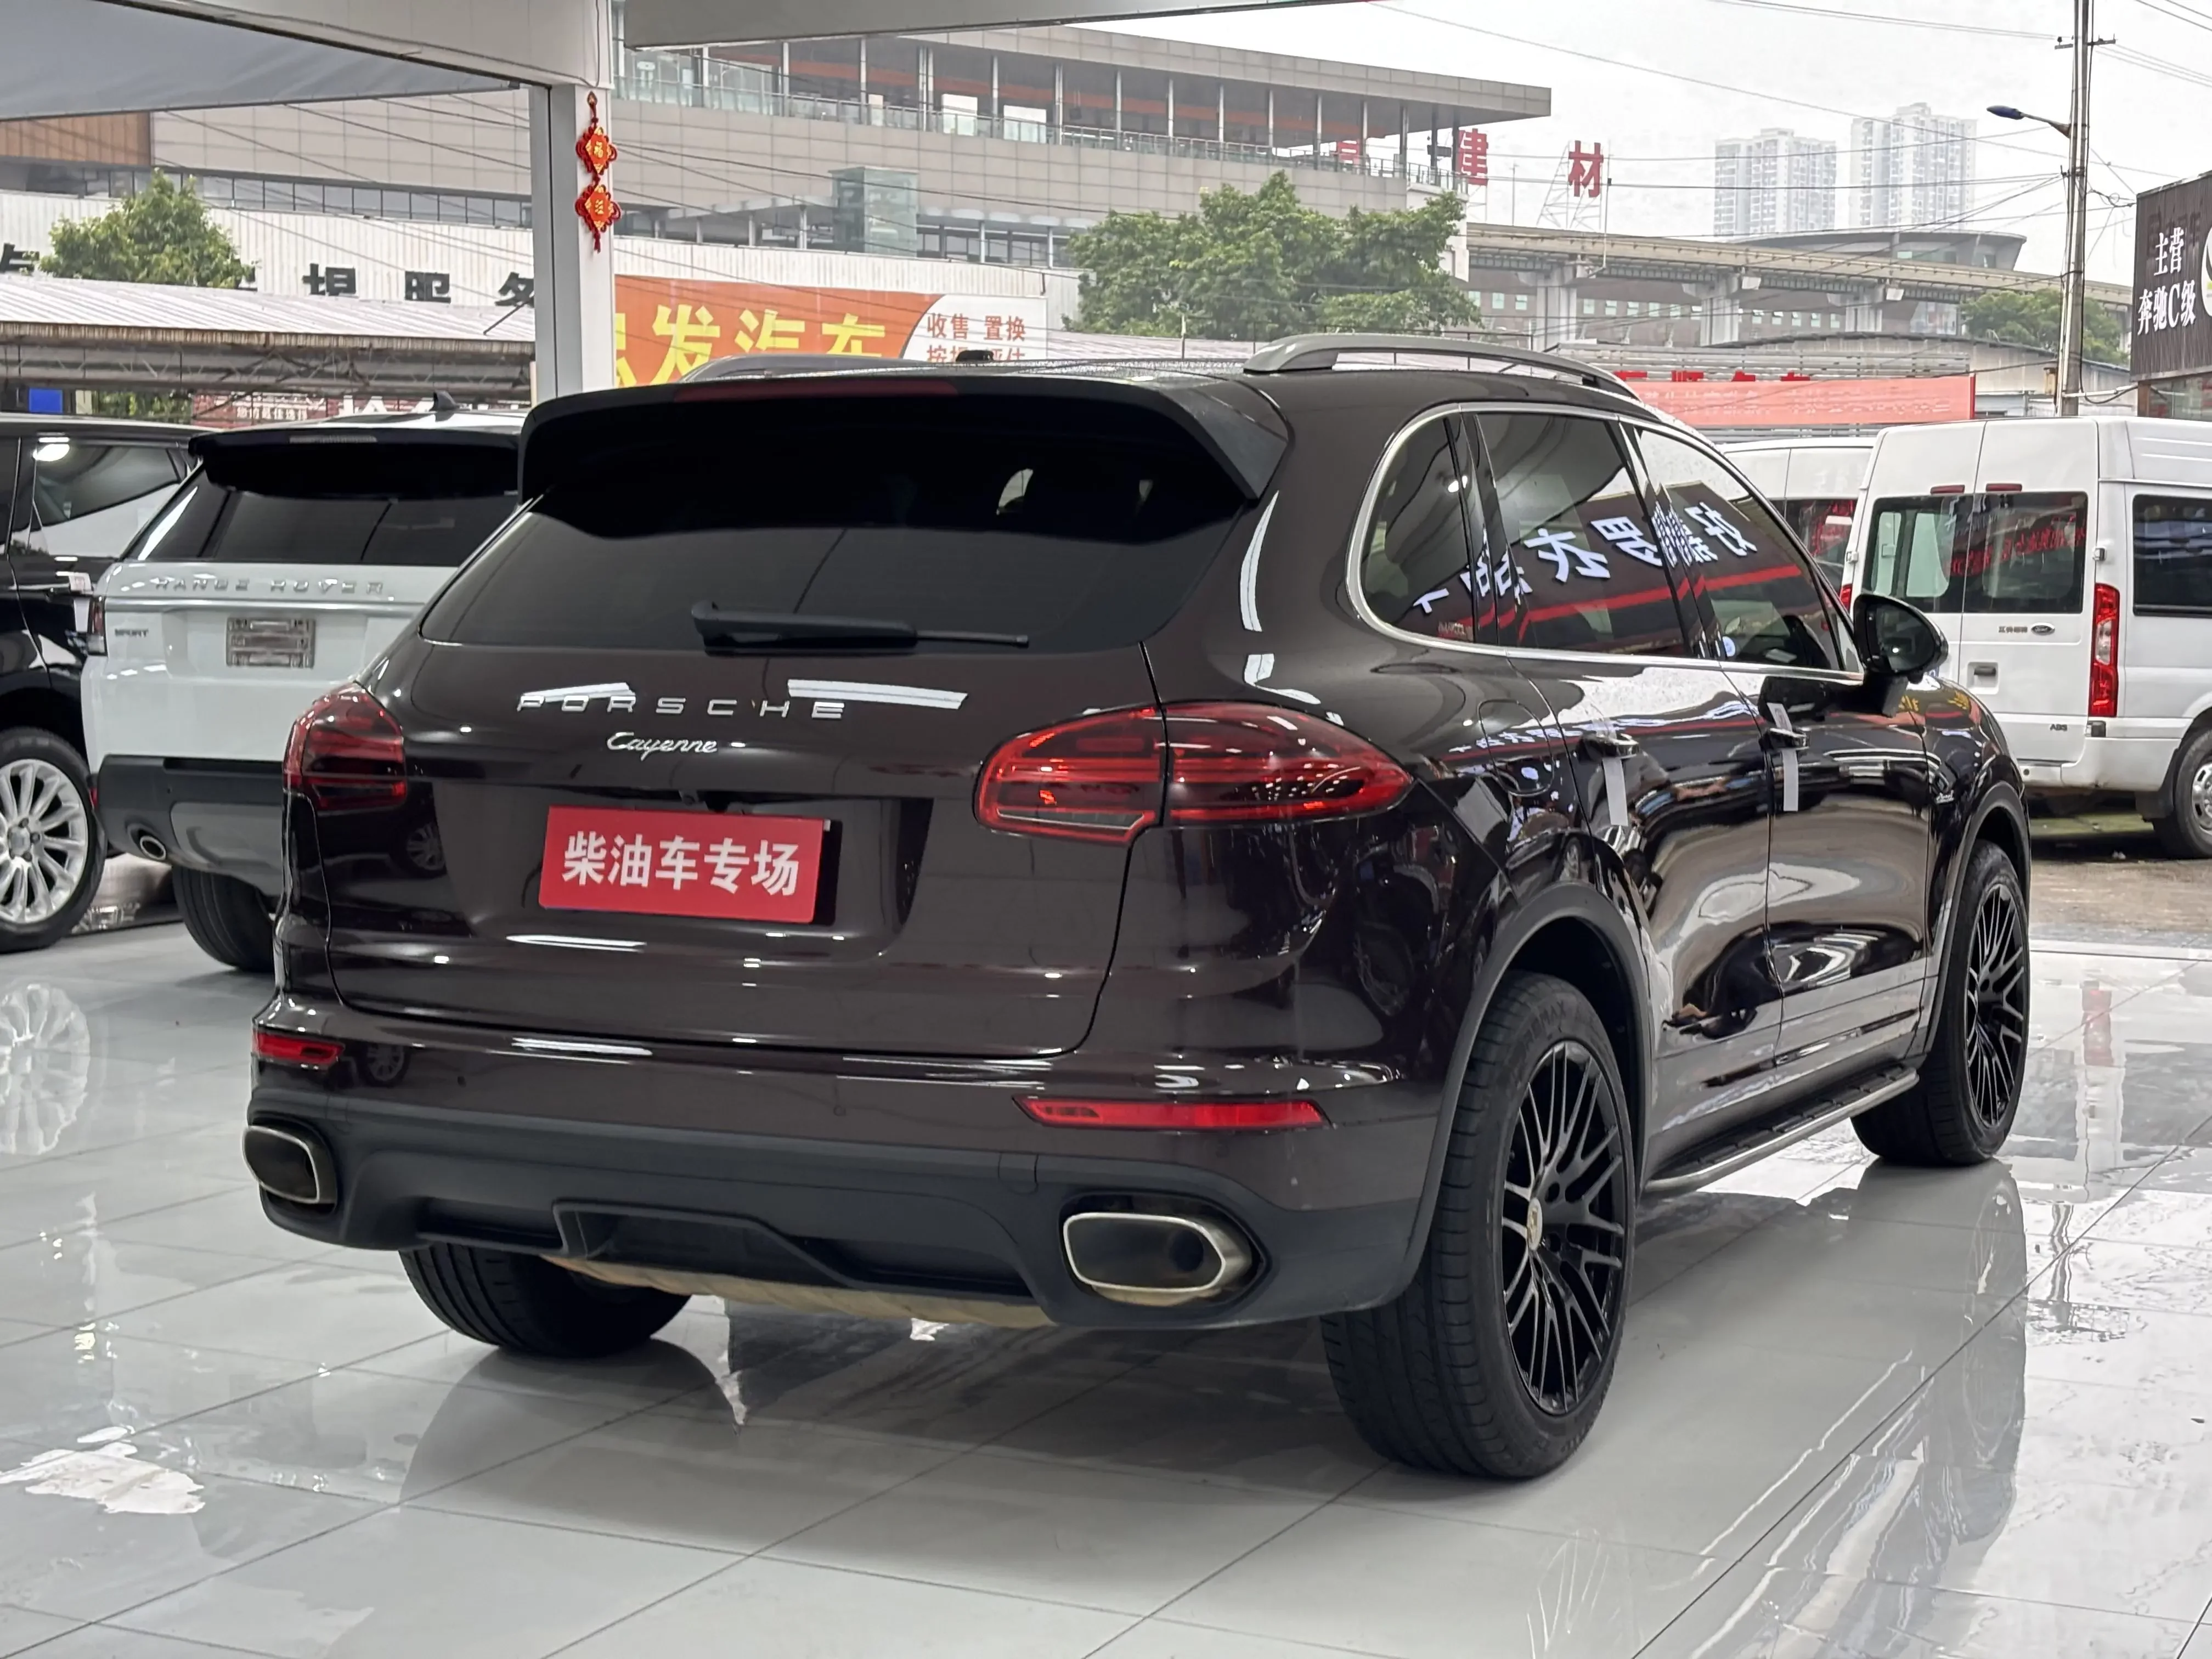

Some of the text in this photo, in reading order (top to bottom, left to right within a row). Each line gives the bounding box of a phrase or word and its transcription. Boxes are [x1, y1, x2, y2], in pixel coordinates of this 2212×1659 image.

[2153, 226, 2185, 276] 主营
[2137, 279, 2197, 336] 奔驰C级
[927, 313, 1026, 342] 收售 置换
[517, 694, 846, 720] PORSCHE
[606, 732, 718, 760] Cayenne
[561, 830, 799, 896] 柴油车专场
